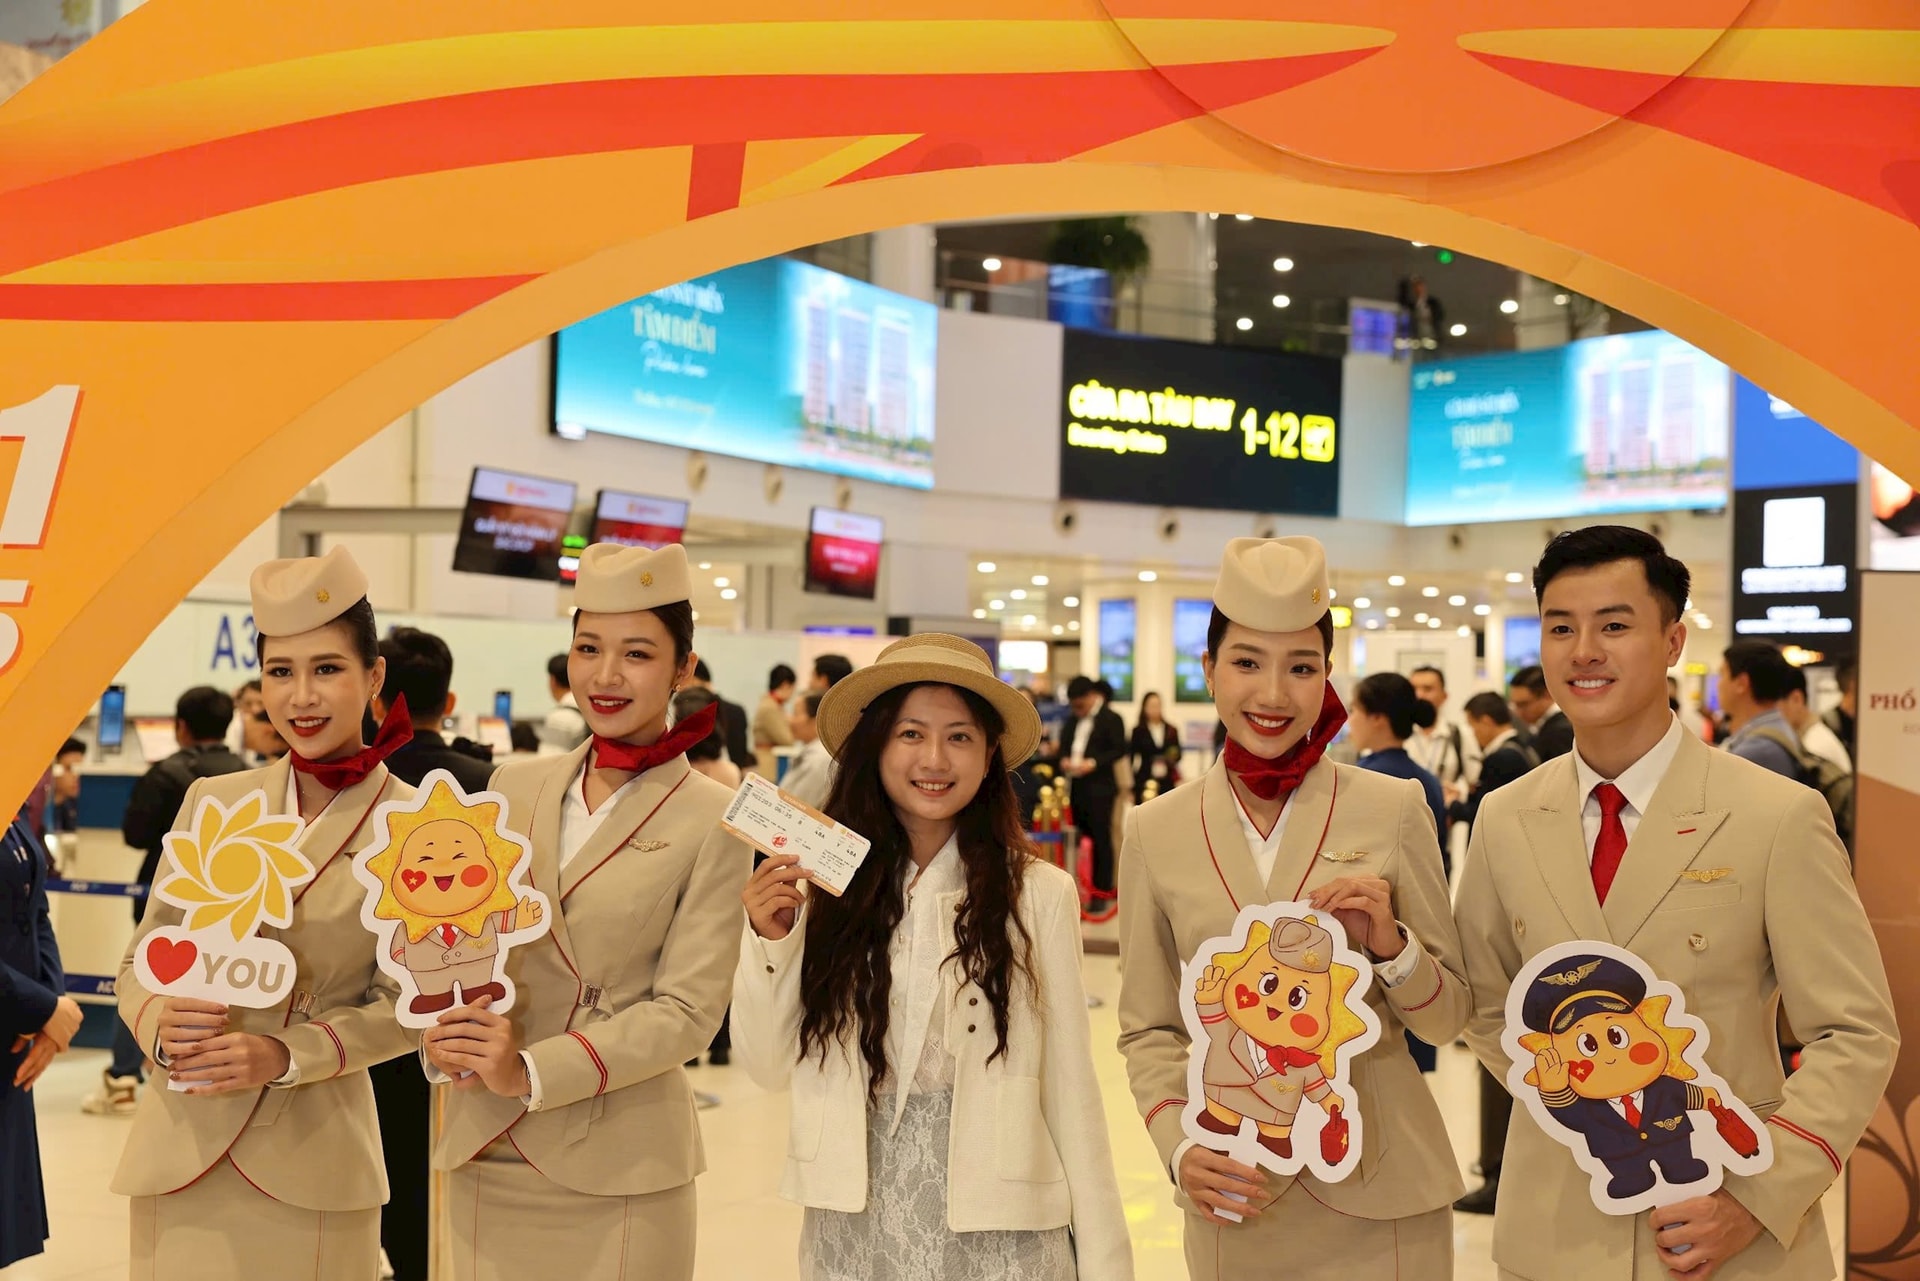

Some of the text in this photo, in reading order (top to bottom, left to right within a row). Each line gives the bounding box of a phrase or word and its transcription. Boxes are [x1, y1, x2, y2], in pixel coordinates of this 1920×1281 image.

[1117, 388, 1151, 424] RA
[1240, 407, 1300, 459] 1-12
[202, 952, 287, 994] YOU
